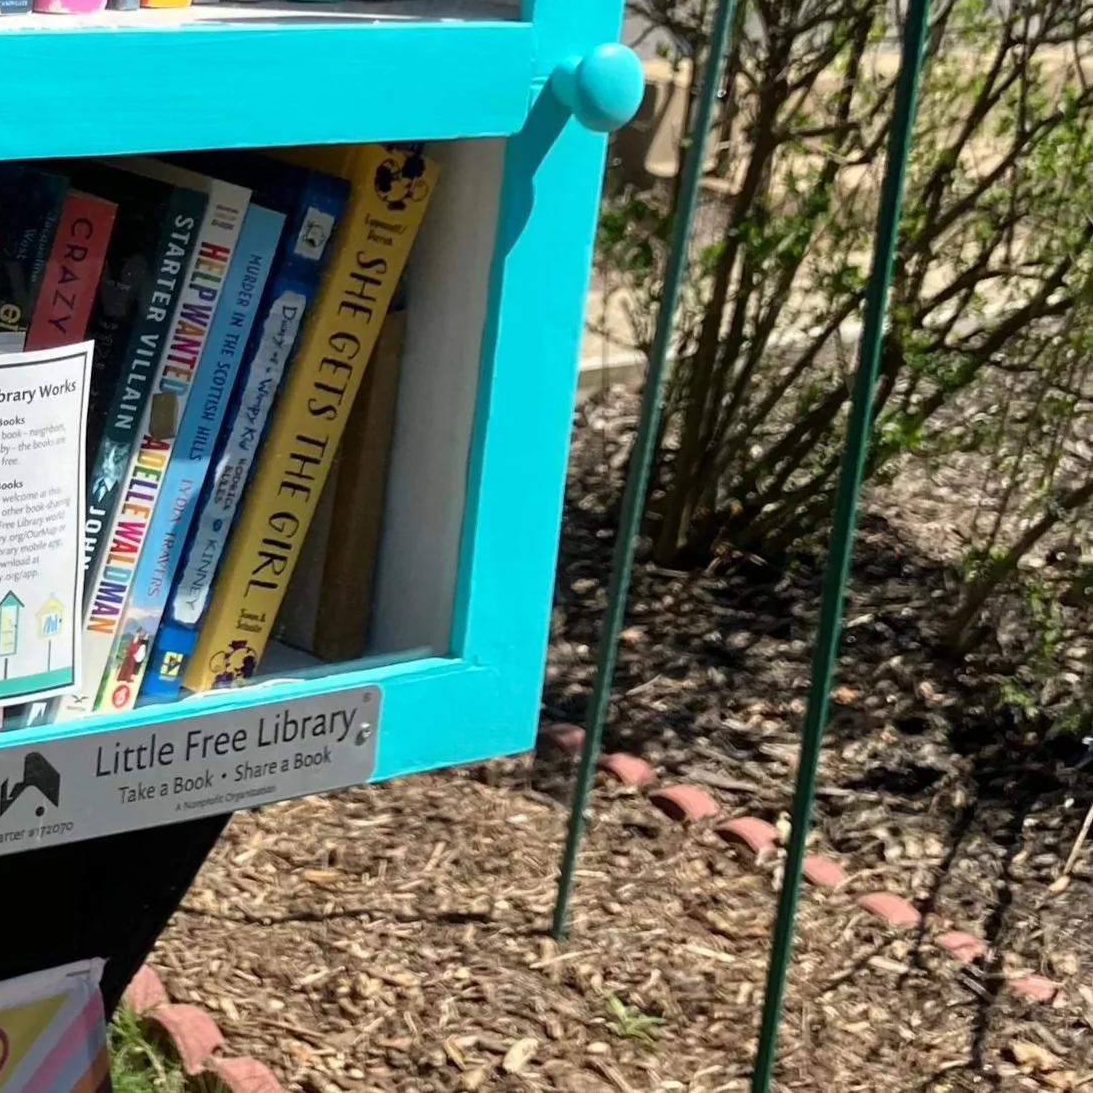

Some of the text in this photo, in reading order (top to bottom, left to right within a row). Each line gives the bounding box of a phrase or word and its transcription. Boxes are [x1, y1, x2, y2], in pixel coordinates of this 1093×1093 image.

[48, 217, 94, 335] CRAZY
[146, 213, 196, 324] STARTER
[189, 241, 231, 302] HELP
[337, 250, 388, 326] SHE
[159, 303, 214, 398] WANTED
[189, 253, 264, 462] MURDER IN THE SCOTTISH HILLS
[274, 304, 299, 350] Diary
[38, 378, 77, 397] Works
[114, 333, 160, 430] VILLAIN
[307, 331, 362, 422] GETS
[1, 428, 22, 440] book
[18, 442, 32, 452] the
[2, 492, 40, 504] welcome
[213, 464, 232, 505] RULES
[276, 433, 330, 504] THE
[1, 505, 24, 517] other
[16, 515, 44, 530] Library
[86, 434, 171, 635] ADELLE WALDMAN
[147, 477, 195, 599] LYDIA TRAVERS
[20, 541, 47, 554] mobile
[31, 556, 40, 565] at
[185, 538, 218, 611] KINNEY
[242, 510, 301, 599] GIRL
[95, 707, 358, 777] Little Free Library
[117, 745, 333, 805] Take a Book Share a Book
[183, 795, 225, 812] Nonprofit
